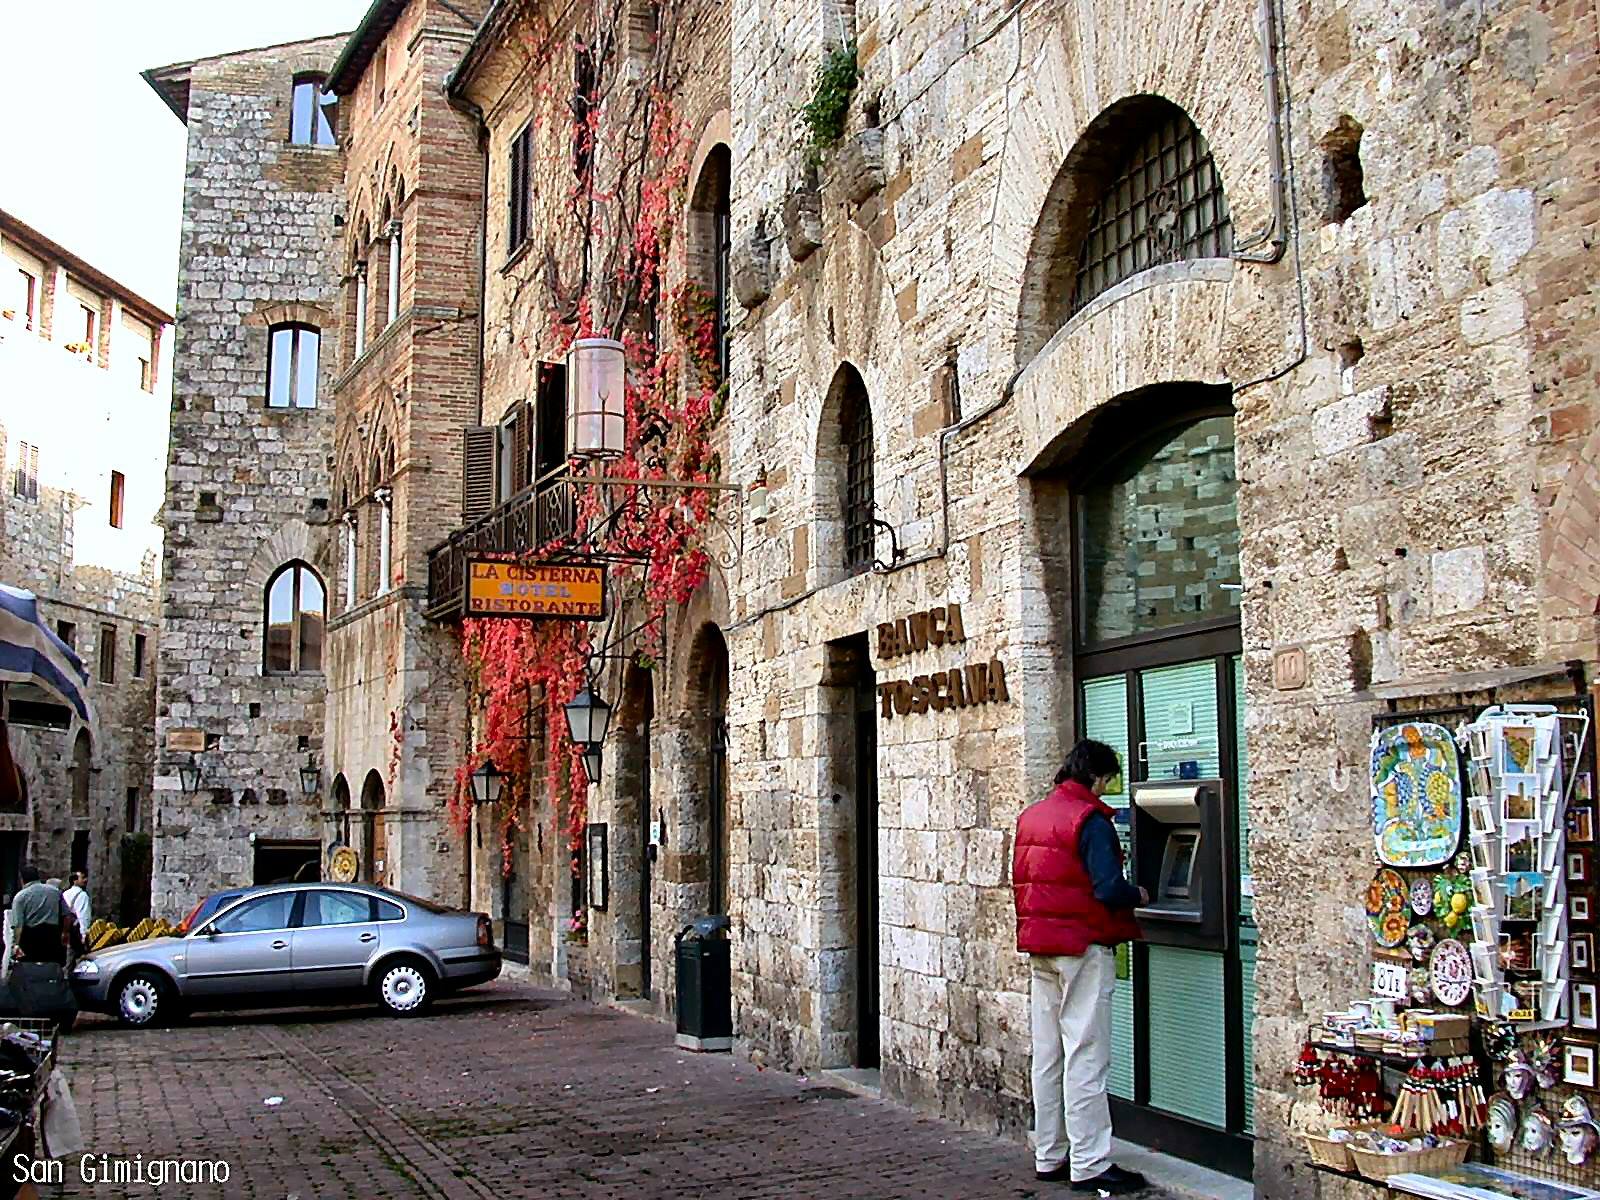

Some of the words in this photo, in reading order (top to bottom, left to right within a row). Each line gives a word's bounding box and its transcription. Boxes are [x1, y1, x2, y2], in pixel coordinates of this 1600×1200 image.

[471, 564, 499, 580] LA
[506, 566, 600, 584] CISTERNA
[499, 583, 572, 598] HOTEL
[471, 598, 600, 616] RISTORANTE
[876, 603, 967, 660] BANCA
[878, 658, 1010, 720] TOSCANA
